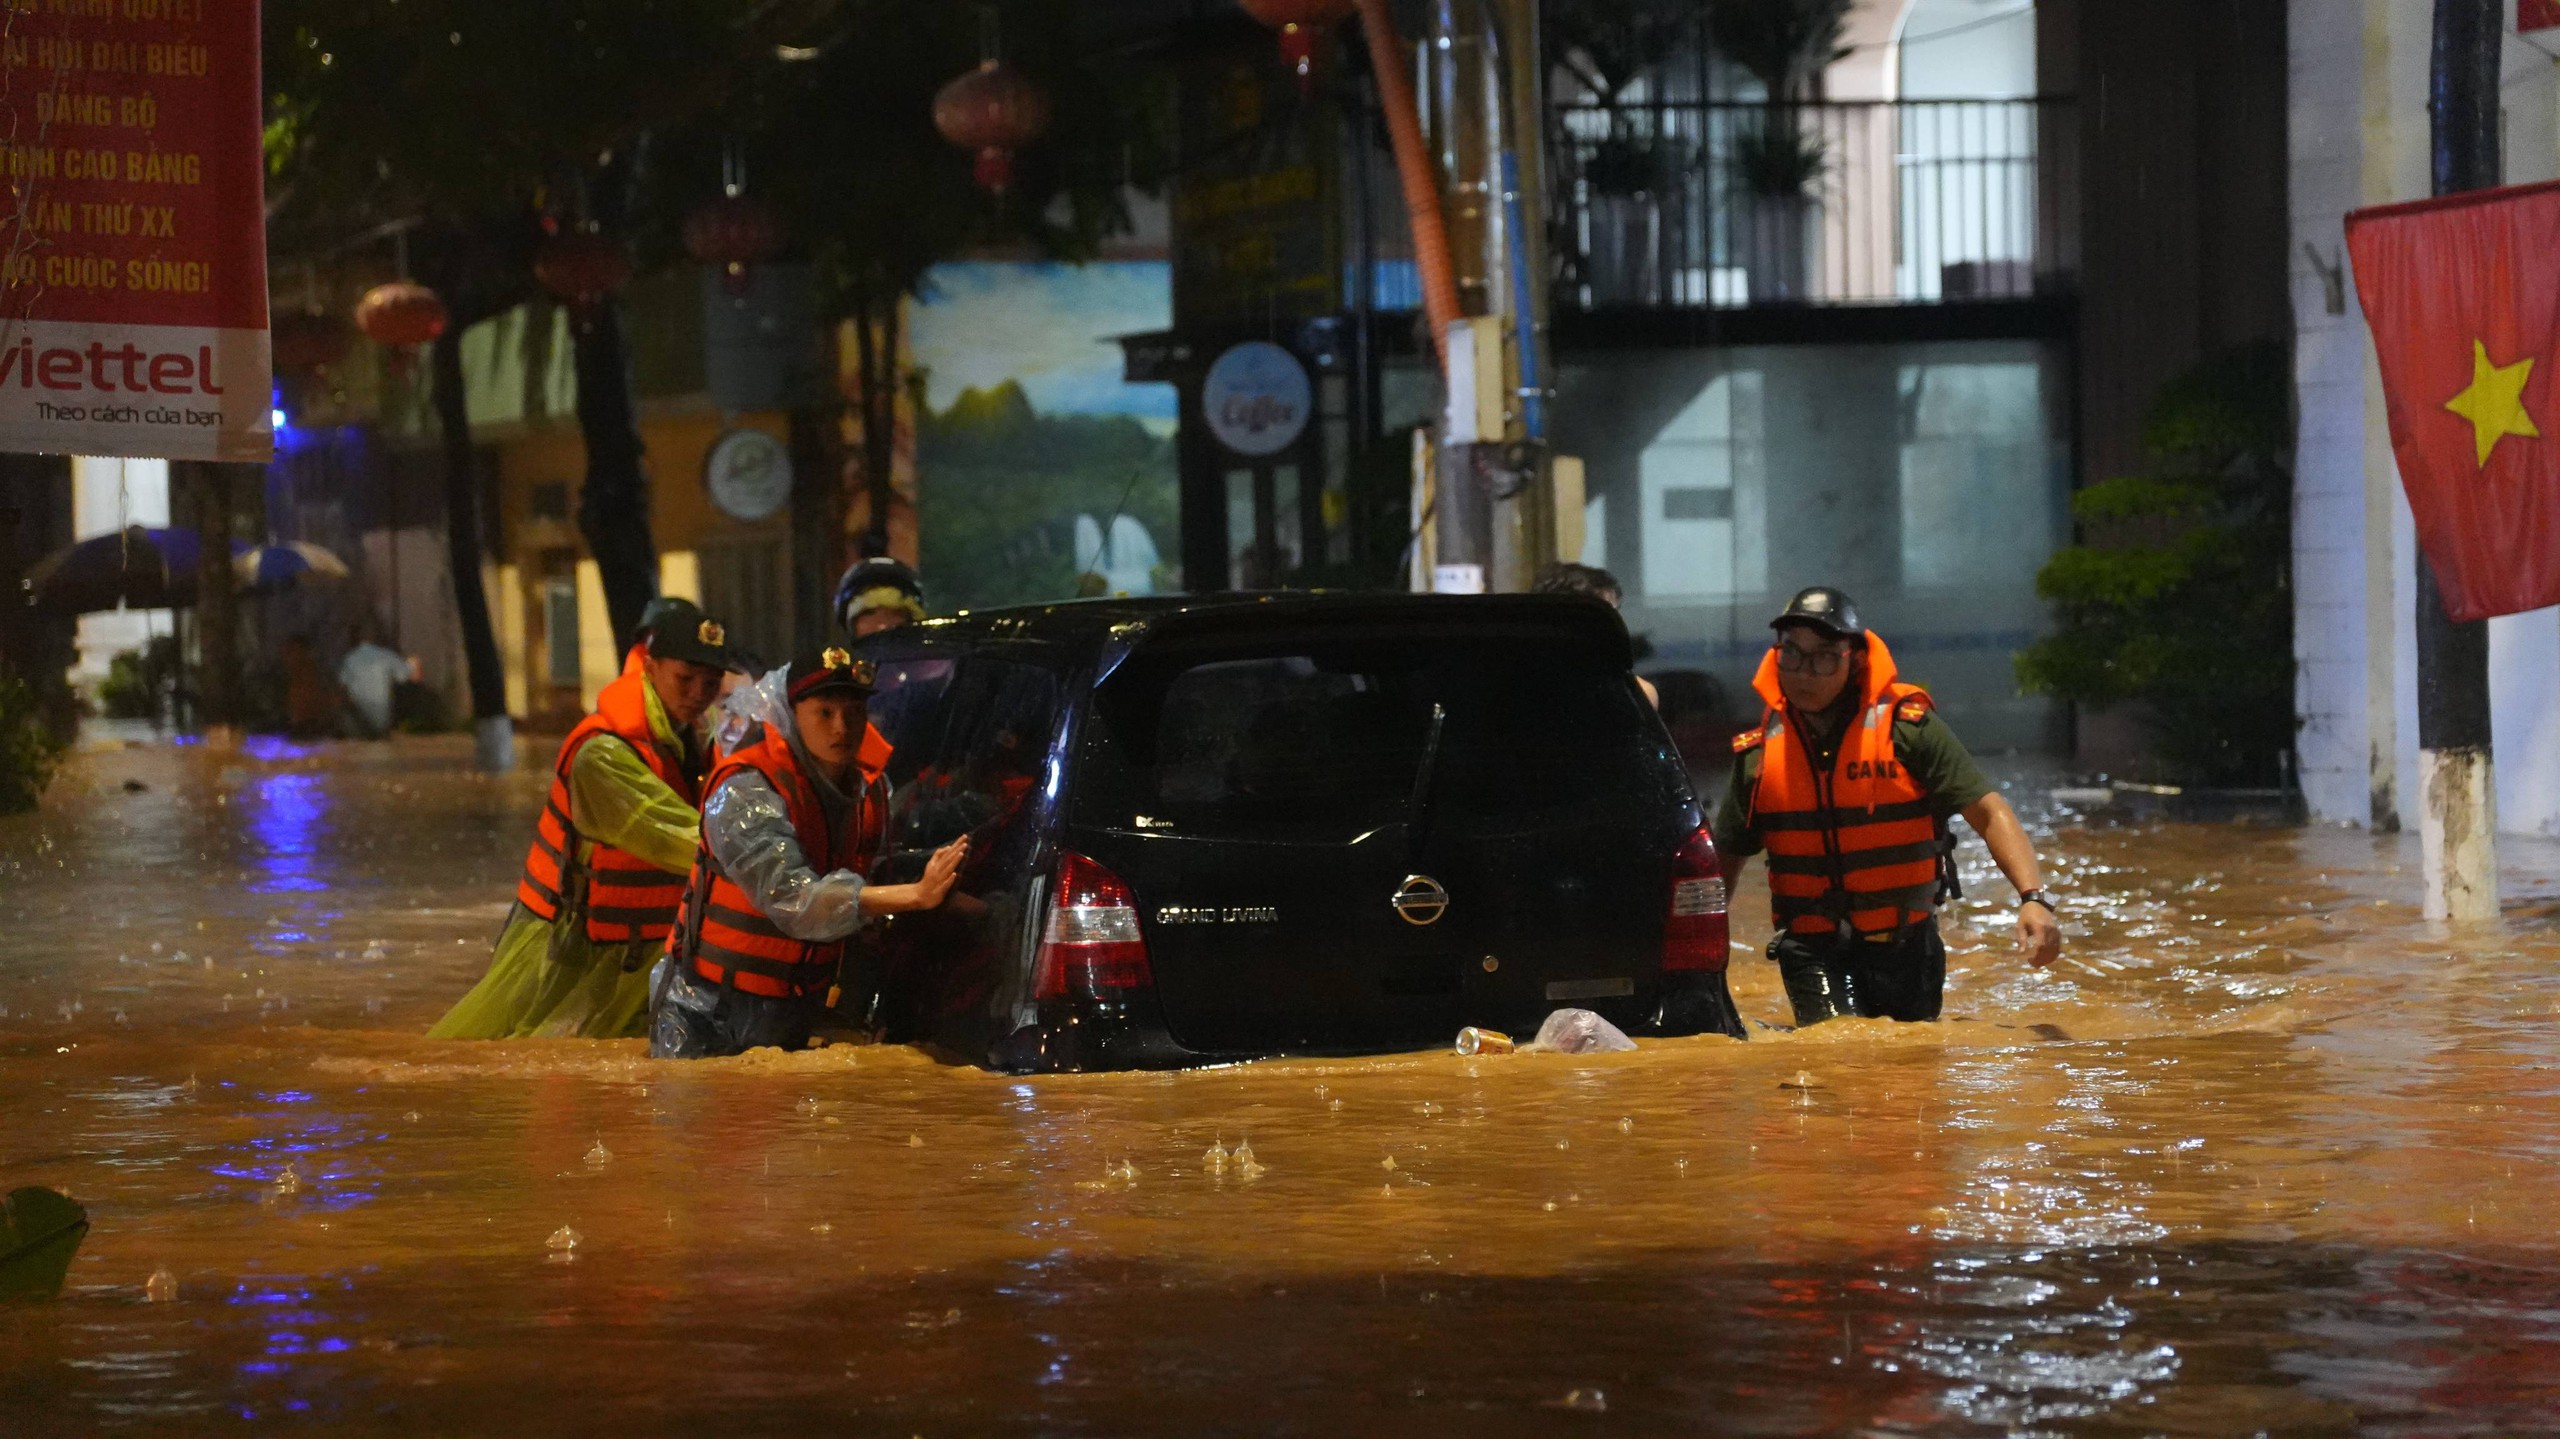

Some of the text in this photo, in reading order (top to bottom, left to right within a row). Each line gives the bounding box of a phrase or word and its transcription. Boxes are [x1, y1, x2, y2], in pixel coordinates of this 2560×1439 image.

[121, 90, 157, 135] BỘ
[64, 147, 118, 180] CAO
[139, 205, 176, 238] XX
[36, 402, 224, 427] Theo cách của bạn
[1156, 906, 1279, 924] GRAND LIVINA
